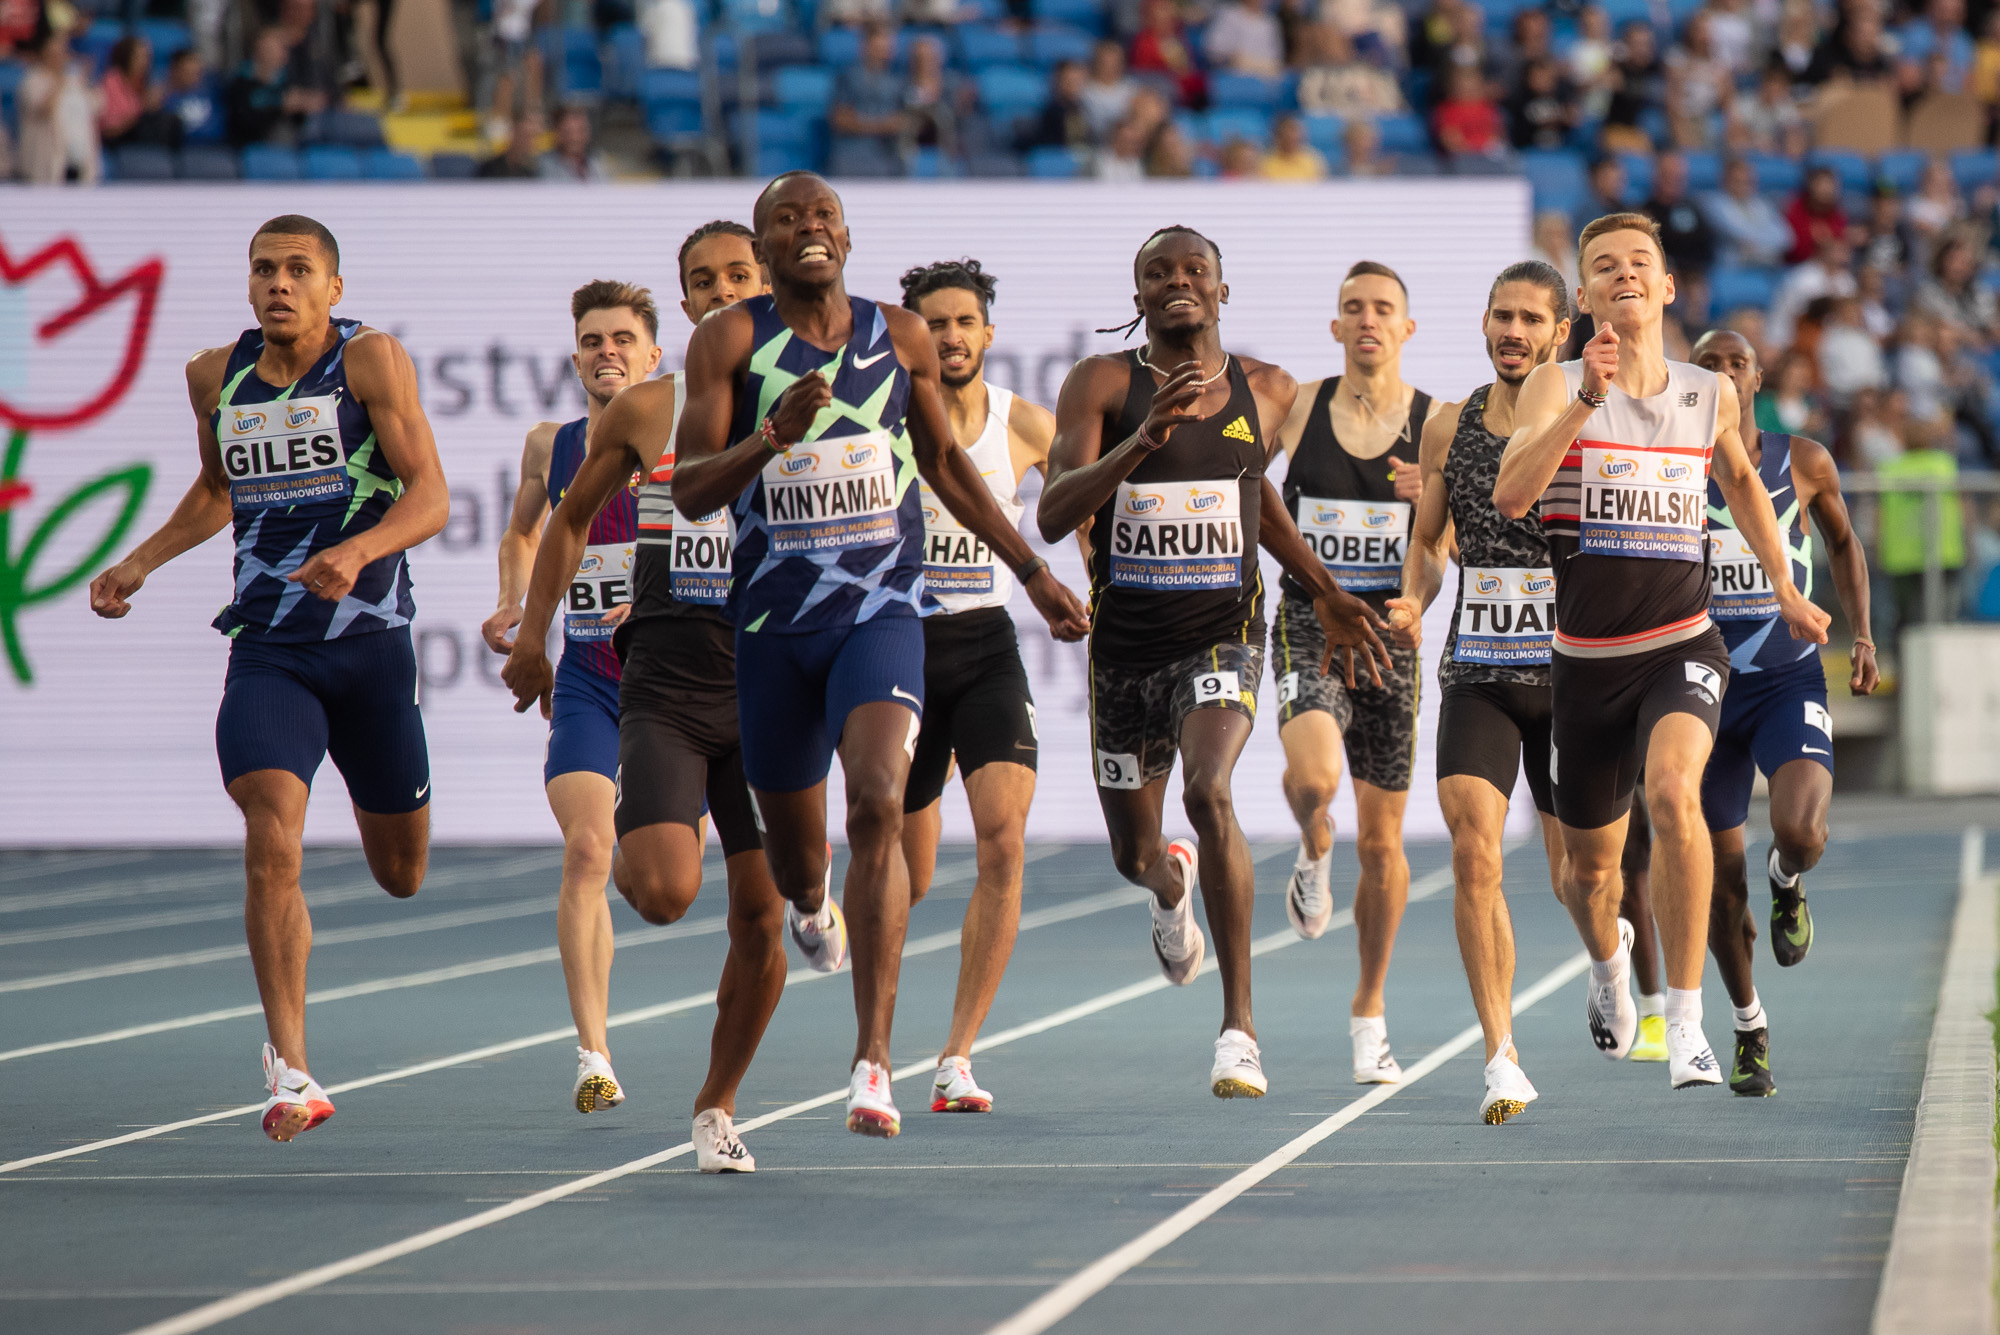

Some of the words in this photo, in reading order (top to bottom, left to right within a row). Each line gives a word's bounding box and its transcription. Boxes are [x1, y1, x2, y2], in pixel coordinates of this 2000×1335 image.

[237, 416, 260, 430] LOTTO
[290, 410, 312, 425] LOTTO
[1222, 428, 1254, 444] adidas
[225, 434, 338, 477] GILES
[786, 457, 812, 472] LOTTO
[849, 448, 872, 464] LOTTO
[1607, 463, 1632, 474] LOTTO
[1664, 466, 1687, 478] LOTTO
[259, 482, 290, 492] SILESIA
[291, 474, 342, 486] MEMORIAŁ
[264, 482, 344, 502] SKOLIMOWSKIEJ
[770, 474, 892, 522] KINYAMAL
[1132, 498, 1156, 511] LOTTO
[1193, 495, 1218, 508] LOTTO
[1586, 487, 1700, 526] LEWALSKI
[774, 529, 807, 540] LOTTO
[810, 525, 846, 538] SILESIA
[774, 540, 812, 552] KAMILI
[814, 527, 896, 548] SKOLIMOWSKIEJ
[1115, 522, 1239, 556] SARUNI
[1586, 529, 1618, 538] LOTTO
[1620, 530, 1654, 540] SILESIA
[674, 536, 732, 569] ROW
[1302, 532, 1402, 563] DOBEK
[1586, 538, 1620, 549] KAMILI
[1622, 540, 1699, 554] SKOLIMOWSKIEJ
[581, 558, 597, 570] LOTTO
[1116, 562, 1146, 573] LOTTO
[1148, 564, 1184, 574] SILESIA
[1186, 562, 1236, 574] MEMORIAŁ
[676, 578, 708, 587] LOTTO
[1116, 572, 1150, 584] KAMILI
[1152, 573, 1236, 584] SKOLIMOWSKIEJ
[1480, 580, 1498, 591] LOTTO
[1528, 580, 1551, 592] LOTTO
[570, 580, 627, 610] BE
[676, 588, 712, 598] KAMILI
[569, 628, 599, 636] KAMILI
[1460, 649, 1492, 658] KAMILI
[1461, 640, 1490, 649] LOTTO
[1492, 642, 1520, 650] SILESIA
[1696, 664, 1715, 684] 7
[1202, 677, 1232, 696] 9.
[1103, 758, 1134, 782] 9.
